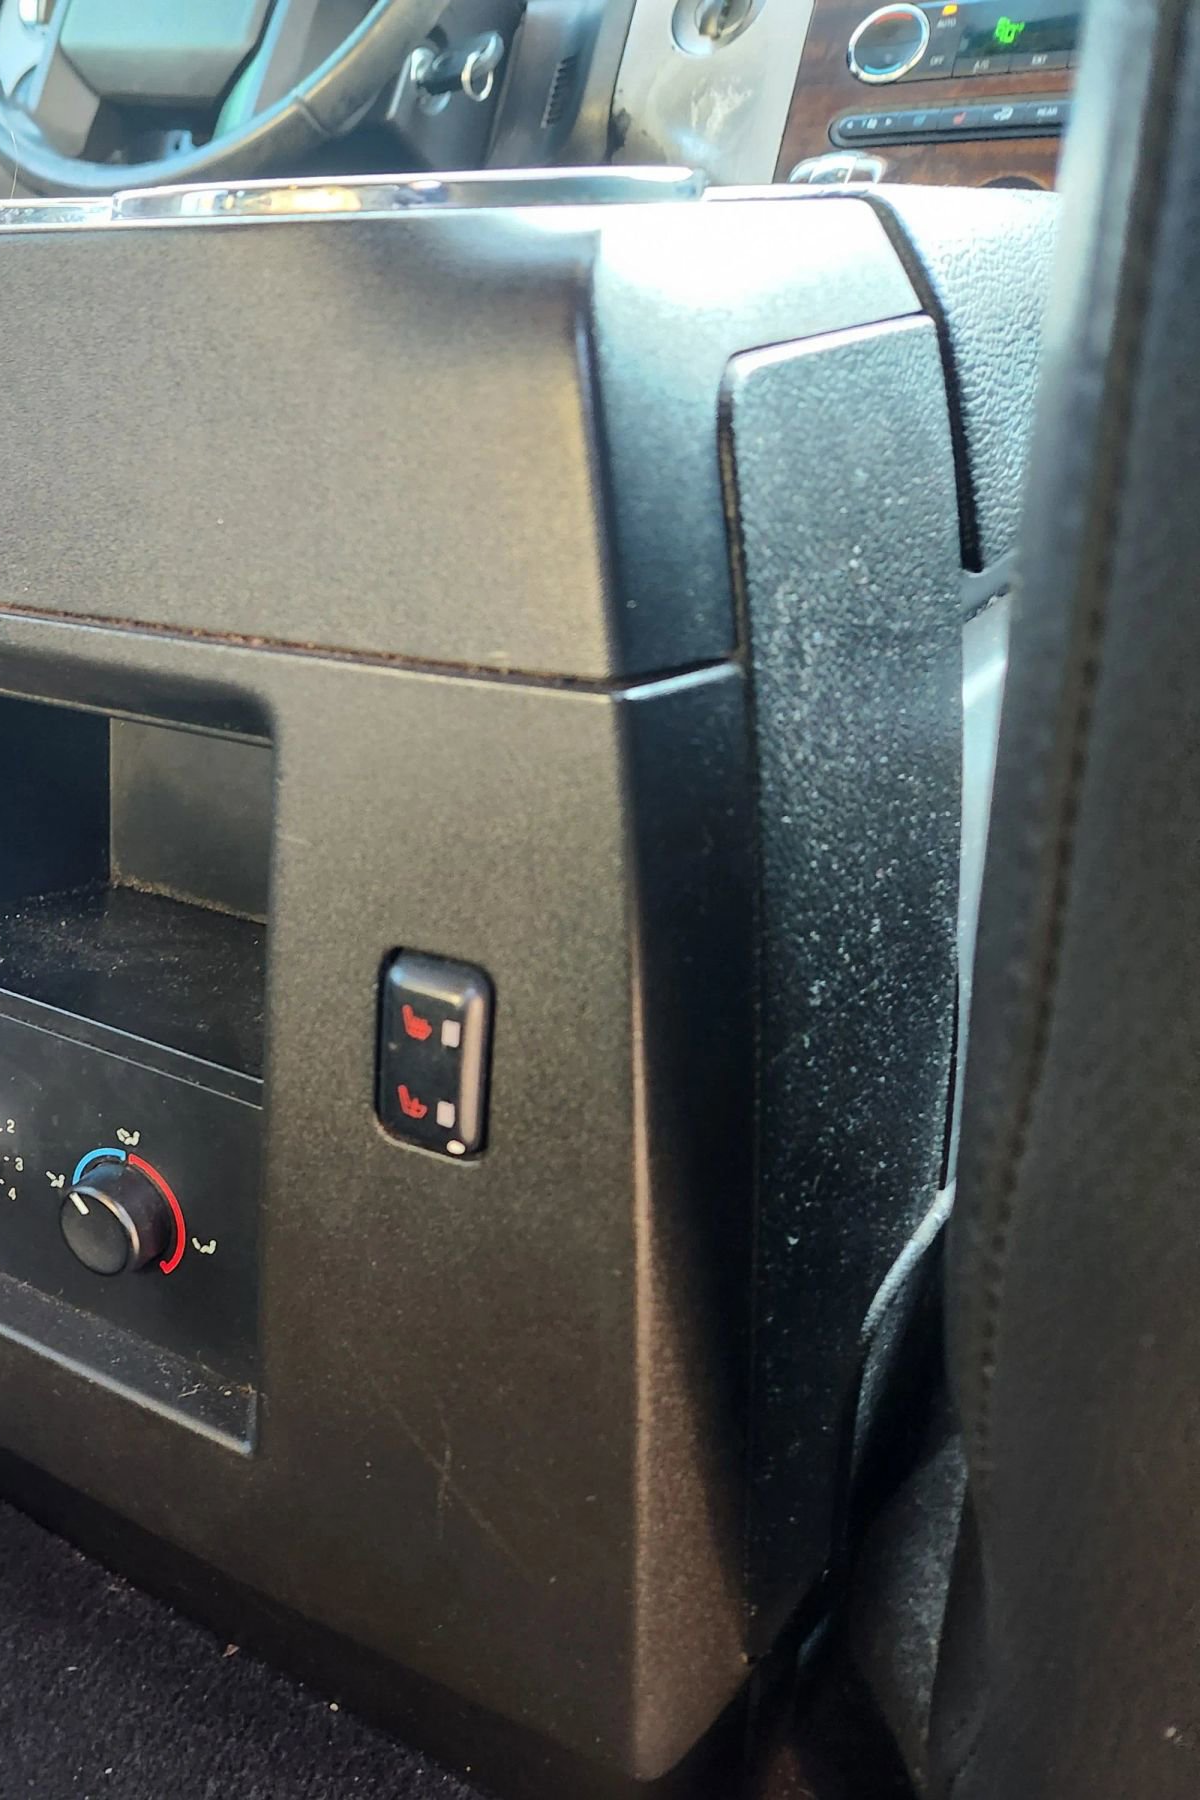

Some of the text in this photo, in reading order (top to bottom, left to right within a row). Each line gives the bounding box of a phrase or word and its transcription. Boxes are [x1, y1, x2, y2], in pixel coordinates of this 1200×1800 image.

[6, 1119, 16, 1133] 2
[15, 1157, 24, 1171] 3
[8, 1187, 17, 1201] 4
